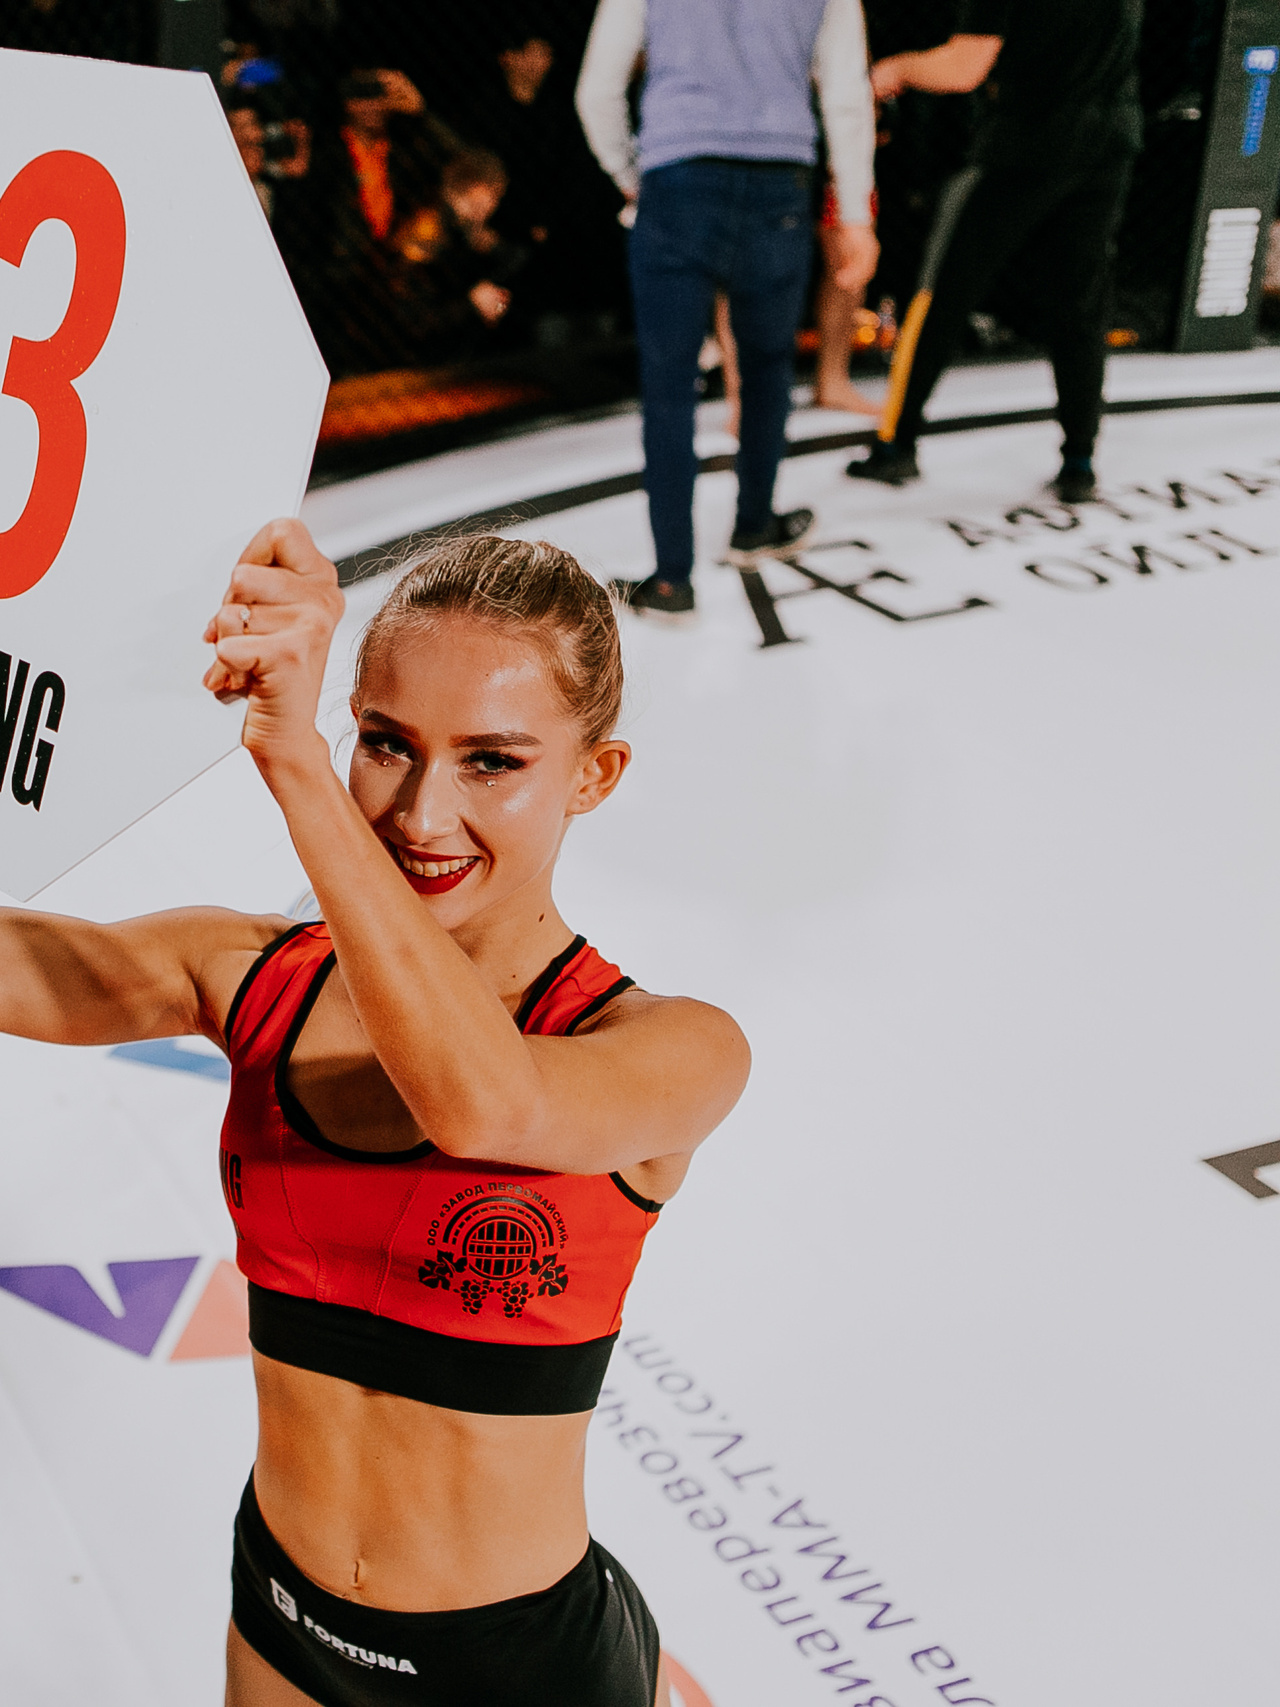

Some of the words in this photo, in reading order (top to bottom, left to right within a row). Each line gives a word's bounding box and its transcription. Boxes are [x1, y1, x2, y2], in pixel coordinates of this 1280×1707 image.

[427, 1220, 440, 1246] ООО
[488, 1182, 568, 1249] ПЕРВОМАЙСКИЙ»
[303, 1614, 418, 1675] FORTUNA
